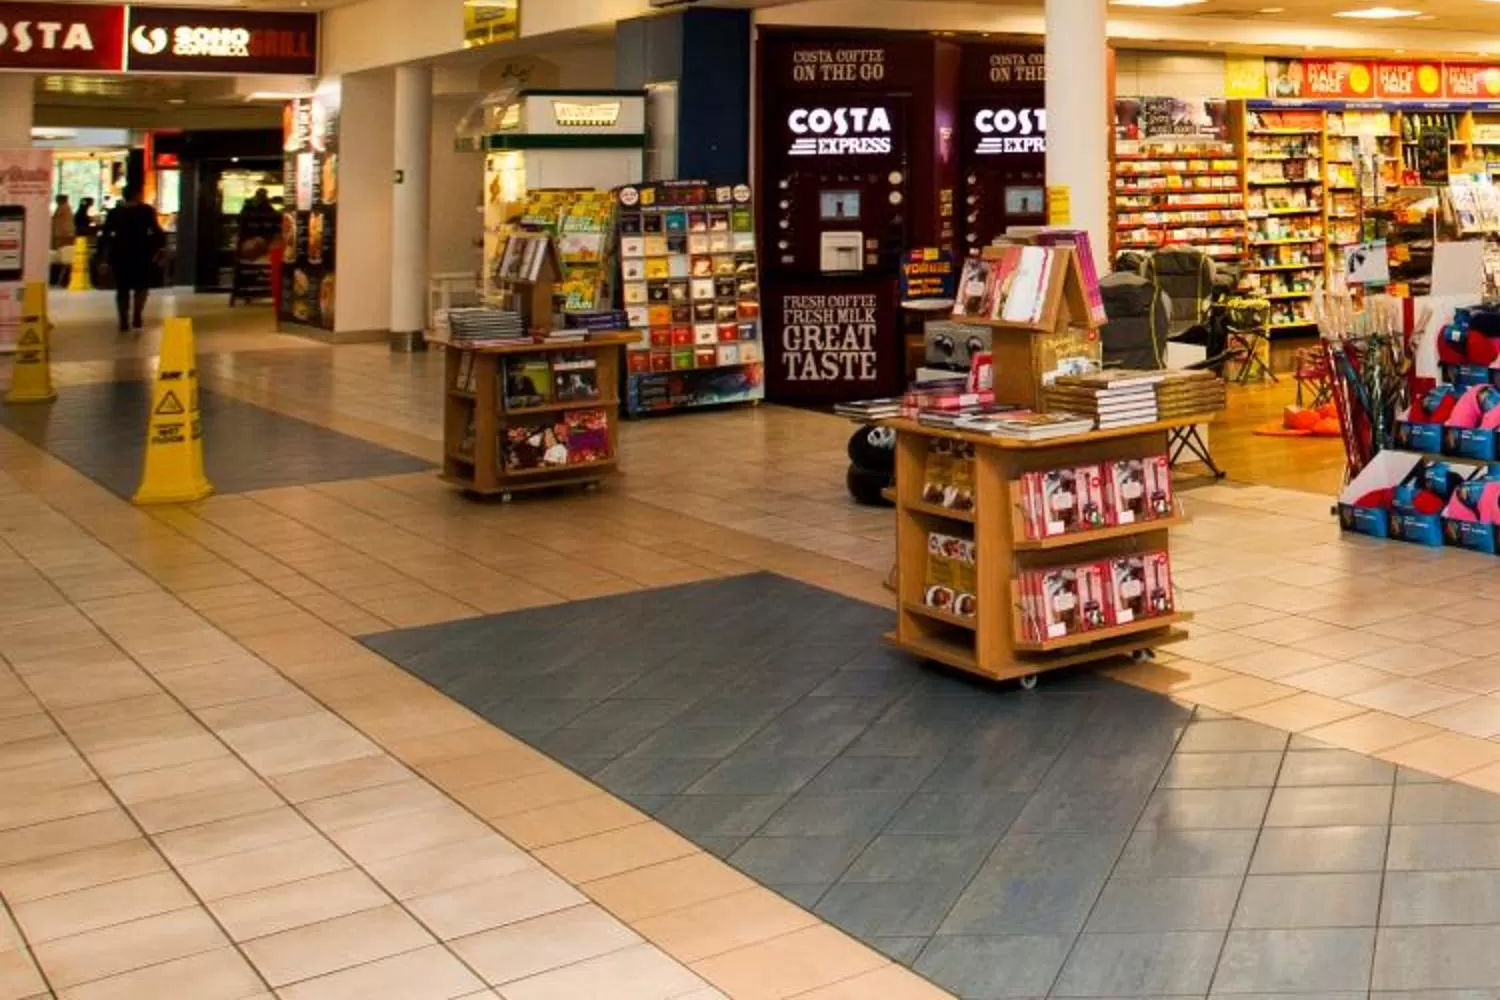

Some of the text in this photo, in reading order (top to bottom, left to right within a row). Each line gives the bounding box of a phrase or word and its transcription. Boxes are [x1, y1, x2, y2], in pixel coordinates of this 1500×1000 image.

[793, 49, 885, 63] COSTA COFFEE
[989, 54, 1026, 67] COSTA
[793, 63, 885, 81] ON THE GO
[990, 67, 1010, 82] ON
[788, 107, 892, 136] COSTA
[817, 137, 891, 155] EXPRESS
[783, 294, 877, 310] FRESH COFFEE
[783, 307, 877, 325] FRESH MILK
[782, 323, 877, 351] GREAT
[781, 351, 878, 381] TASTE
